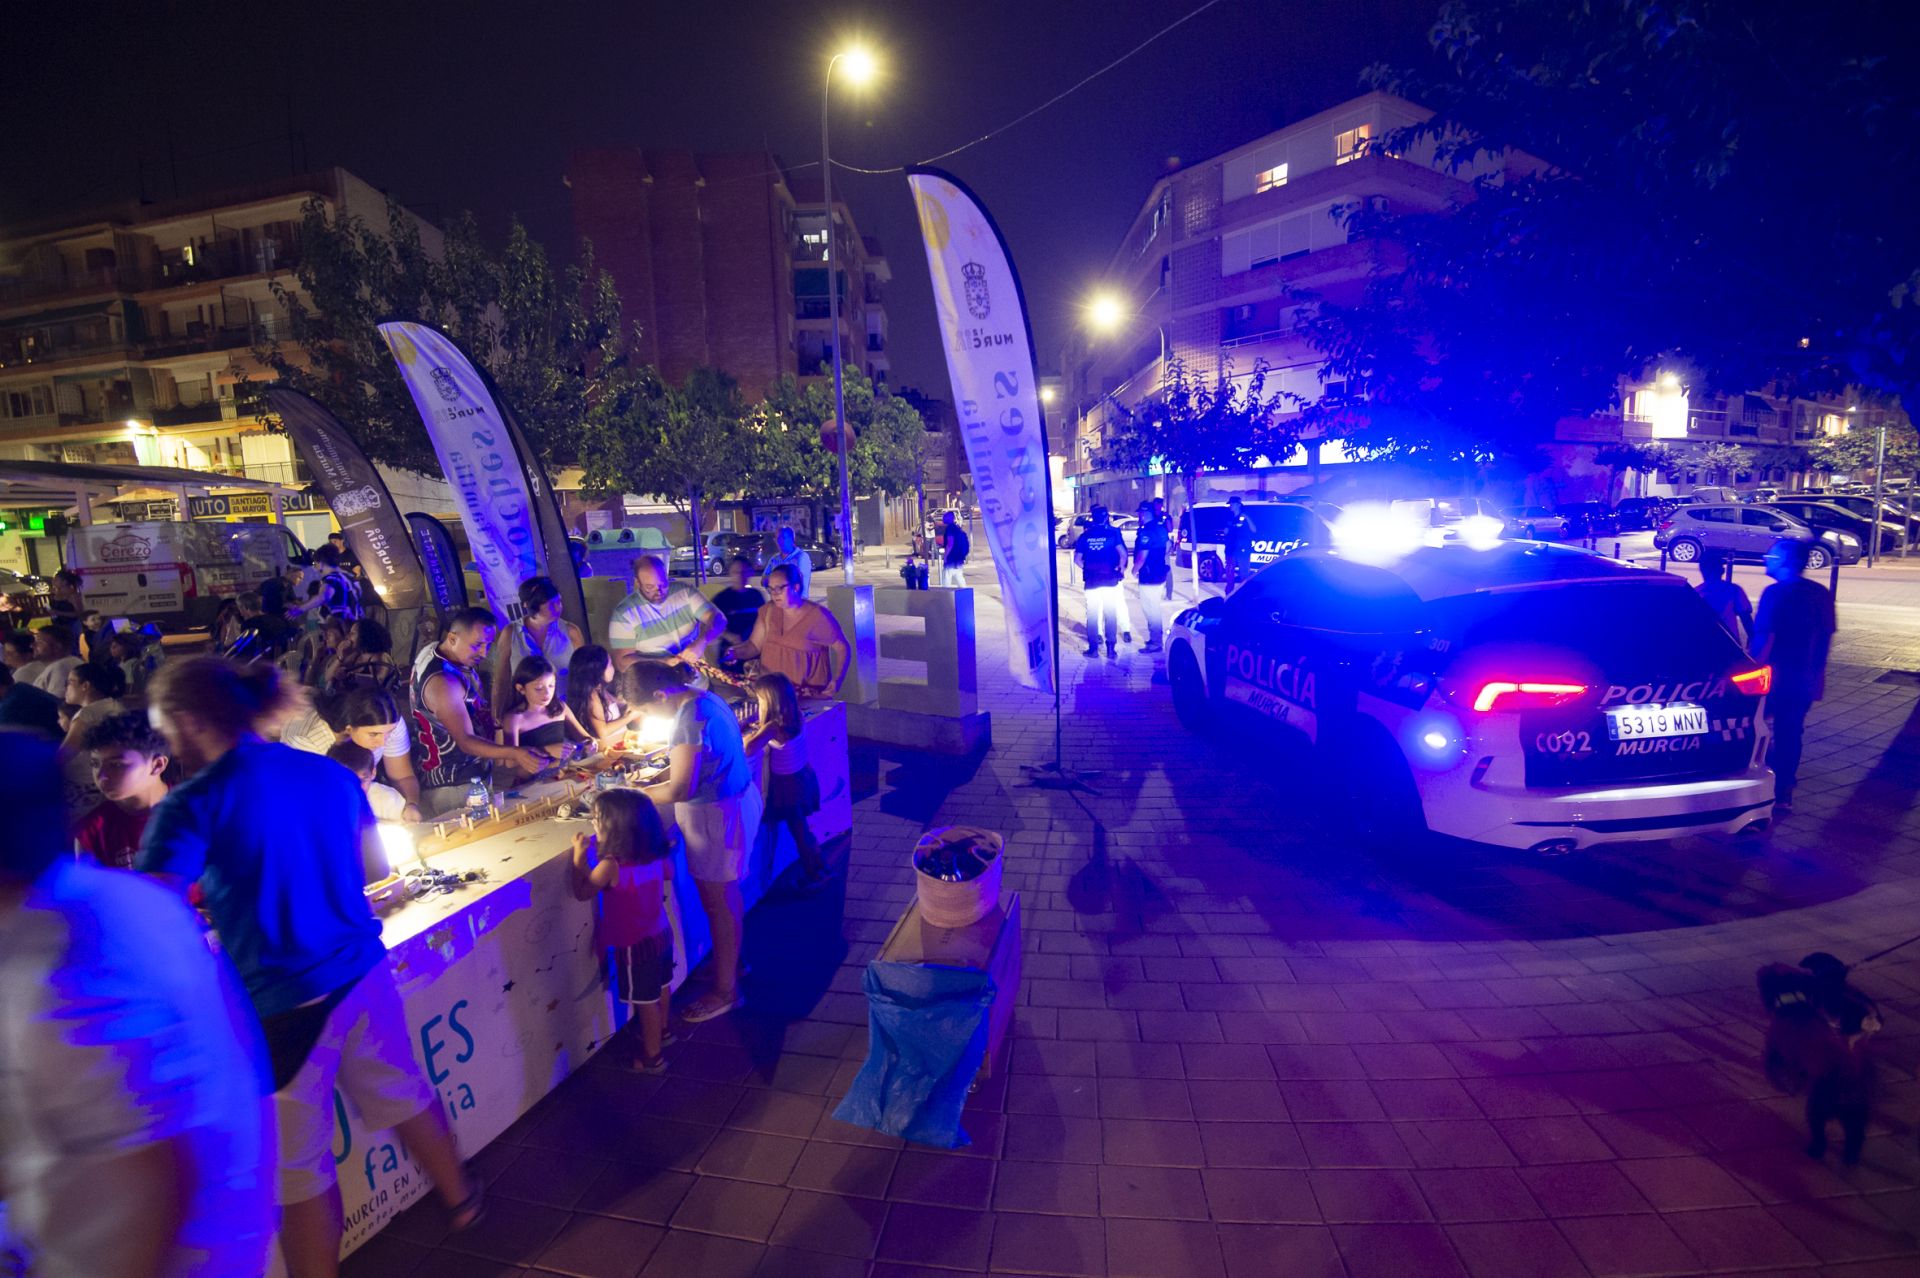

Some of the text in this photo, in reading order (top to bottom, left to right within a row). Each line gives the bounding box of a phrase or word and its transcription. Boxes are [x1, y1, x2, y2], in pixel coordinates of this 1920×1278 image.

[232, 496, 268, 505] SANTIAGO
[243, 505, 267, 513] MAYOR
[101, 542, 151, 558] Cerezo
[1429, 637, 1451, 653] 301
[1227, 644, 1316, 709] POLICÍA
[1600, 674, 1728, 705] POLICÍA
[1248, 690, 1290, 720] MURCIA
[1622, 711, 1704, 735] 5319 MNV
[1616, 737, 1700, 756] MURCIA
[343, 1173, 410, 1233] MURCIA EN
